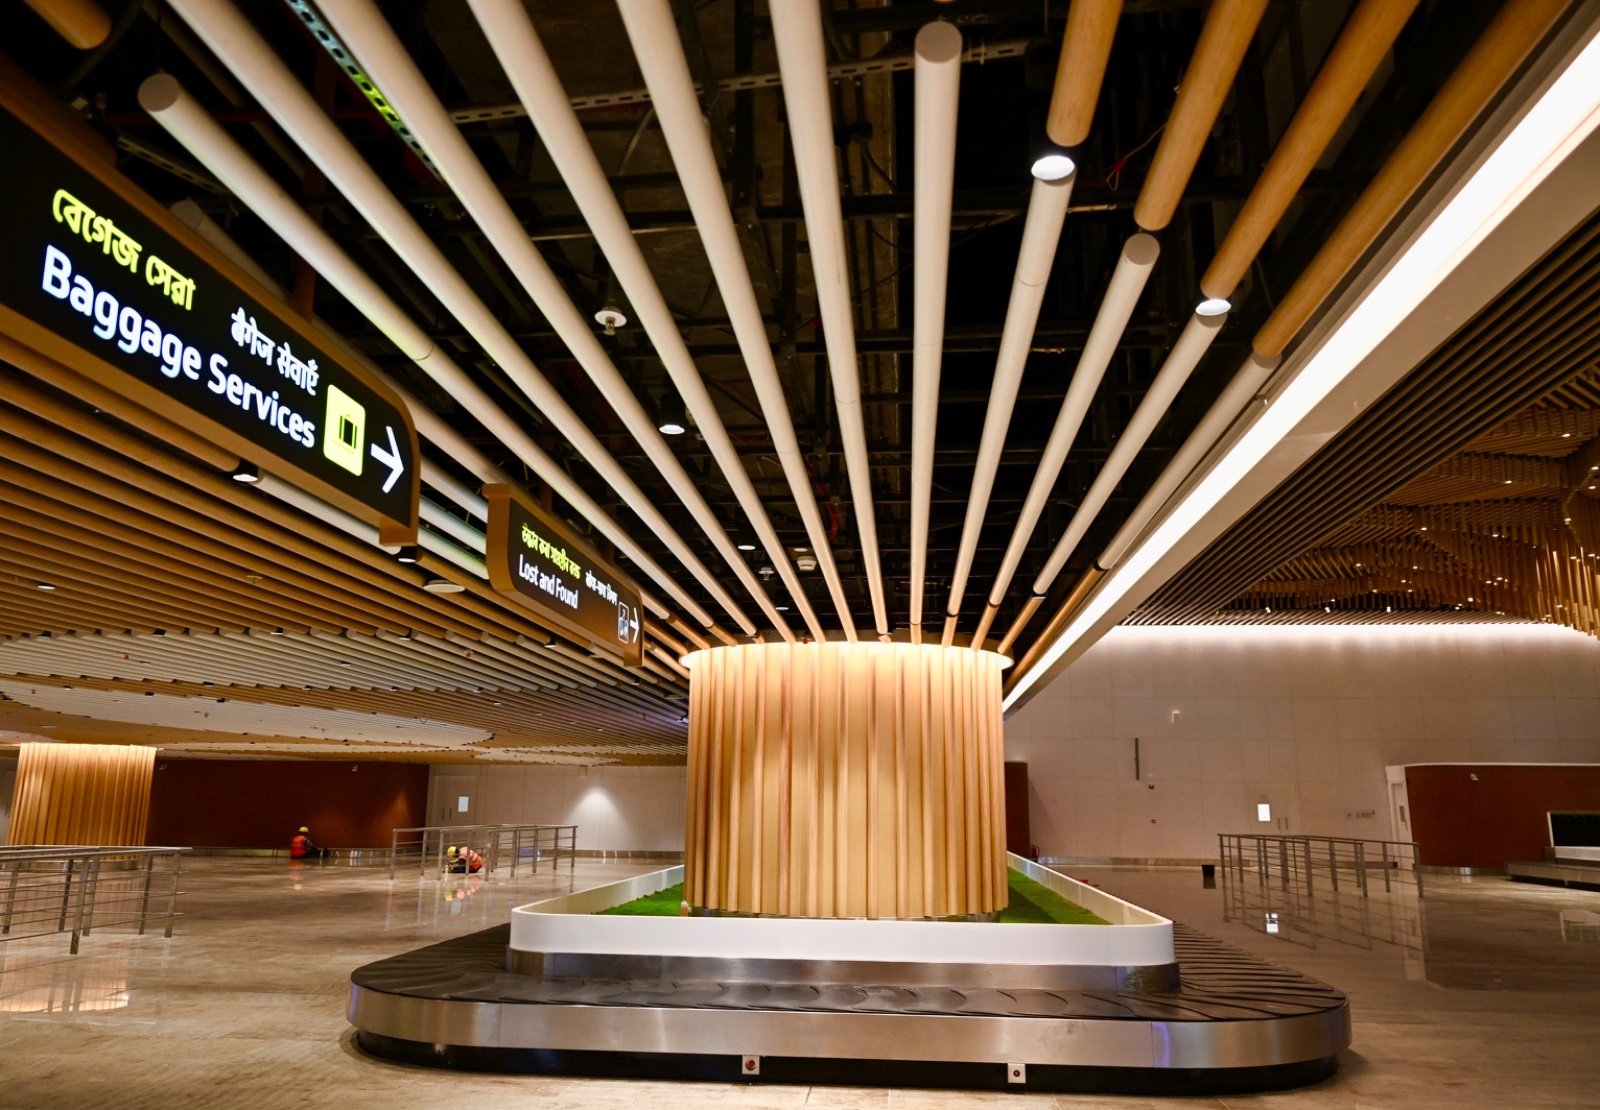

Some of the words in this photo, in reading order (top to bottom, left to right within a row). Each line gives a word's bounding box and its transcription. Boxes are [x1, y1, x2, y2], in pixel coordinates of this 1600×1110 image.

[41, 244, 202, 381] Baggage
[207, 353, 316, 448] Services
[519, 553, 538, 586] Lost
[539, 572, 556, 596] and
[556, 577, 578, 609] Found
